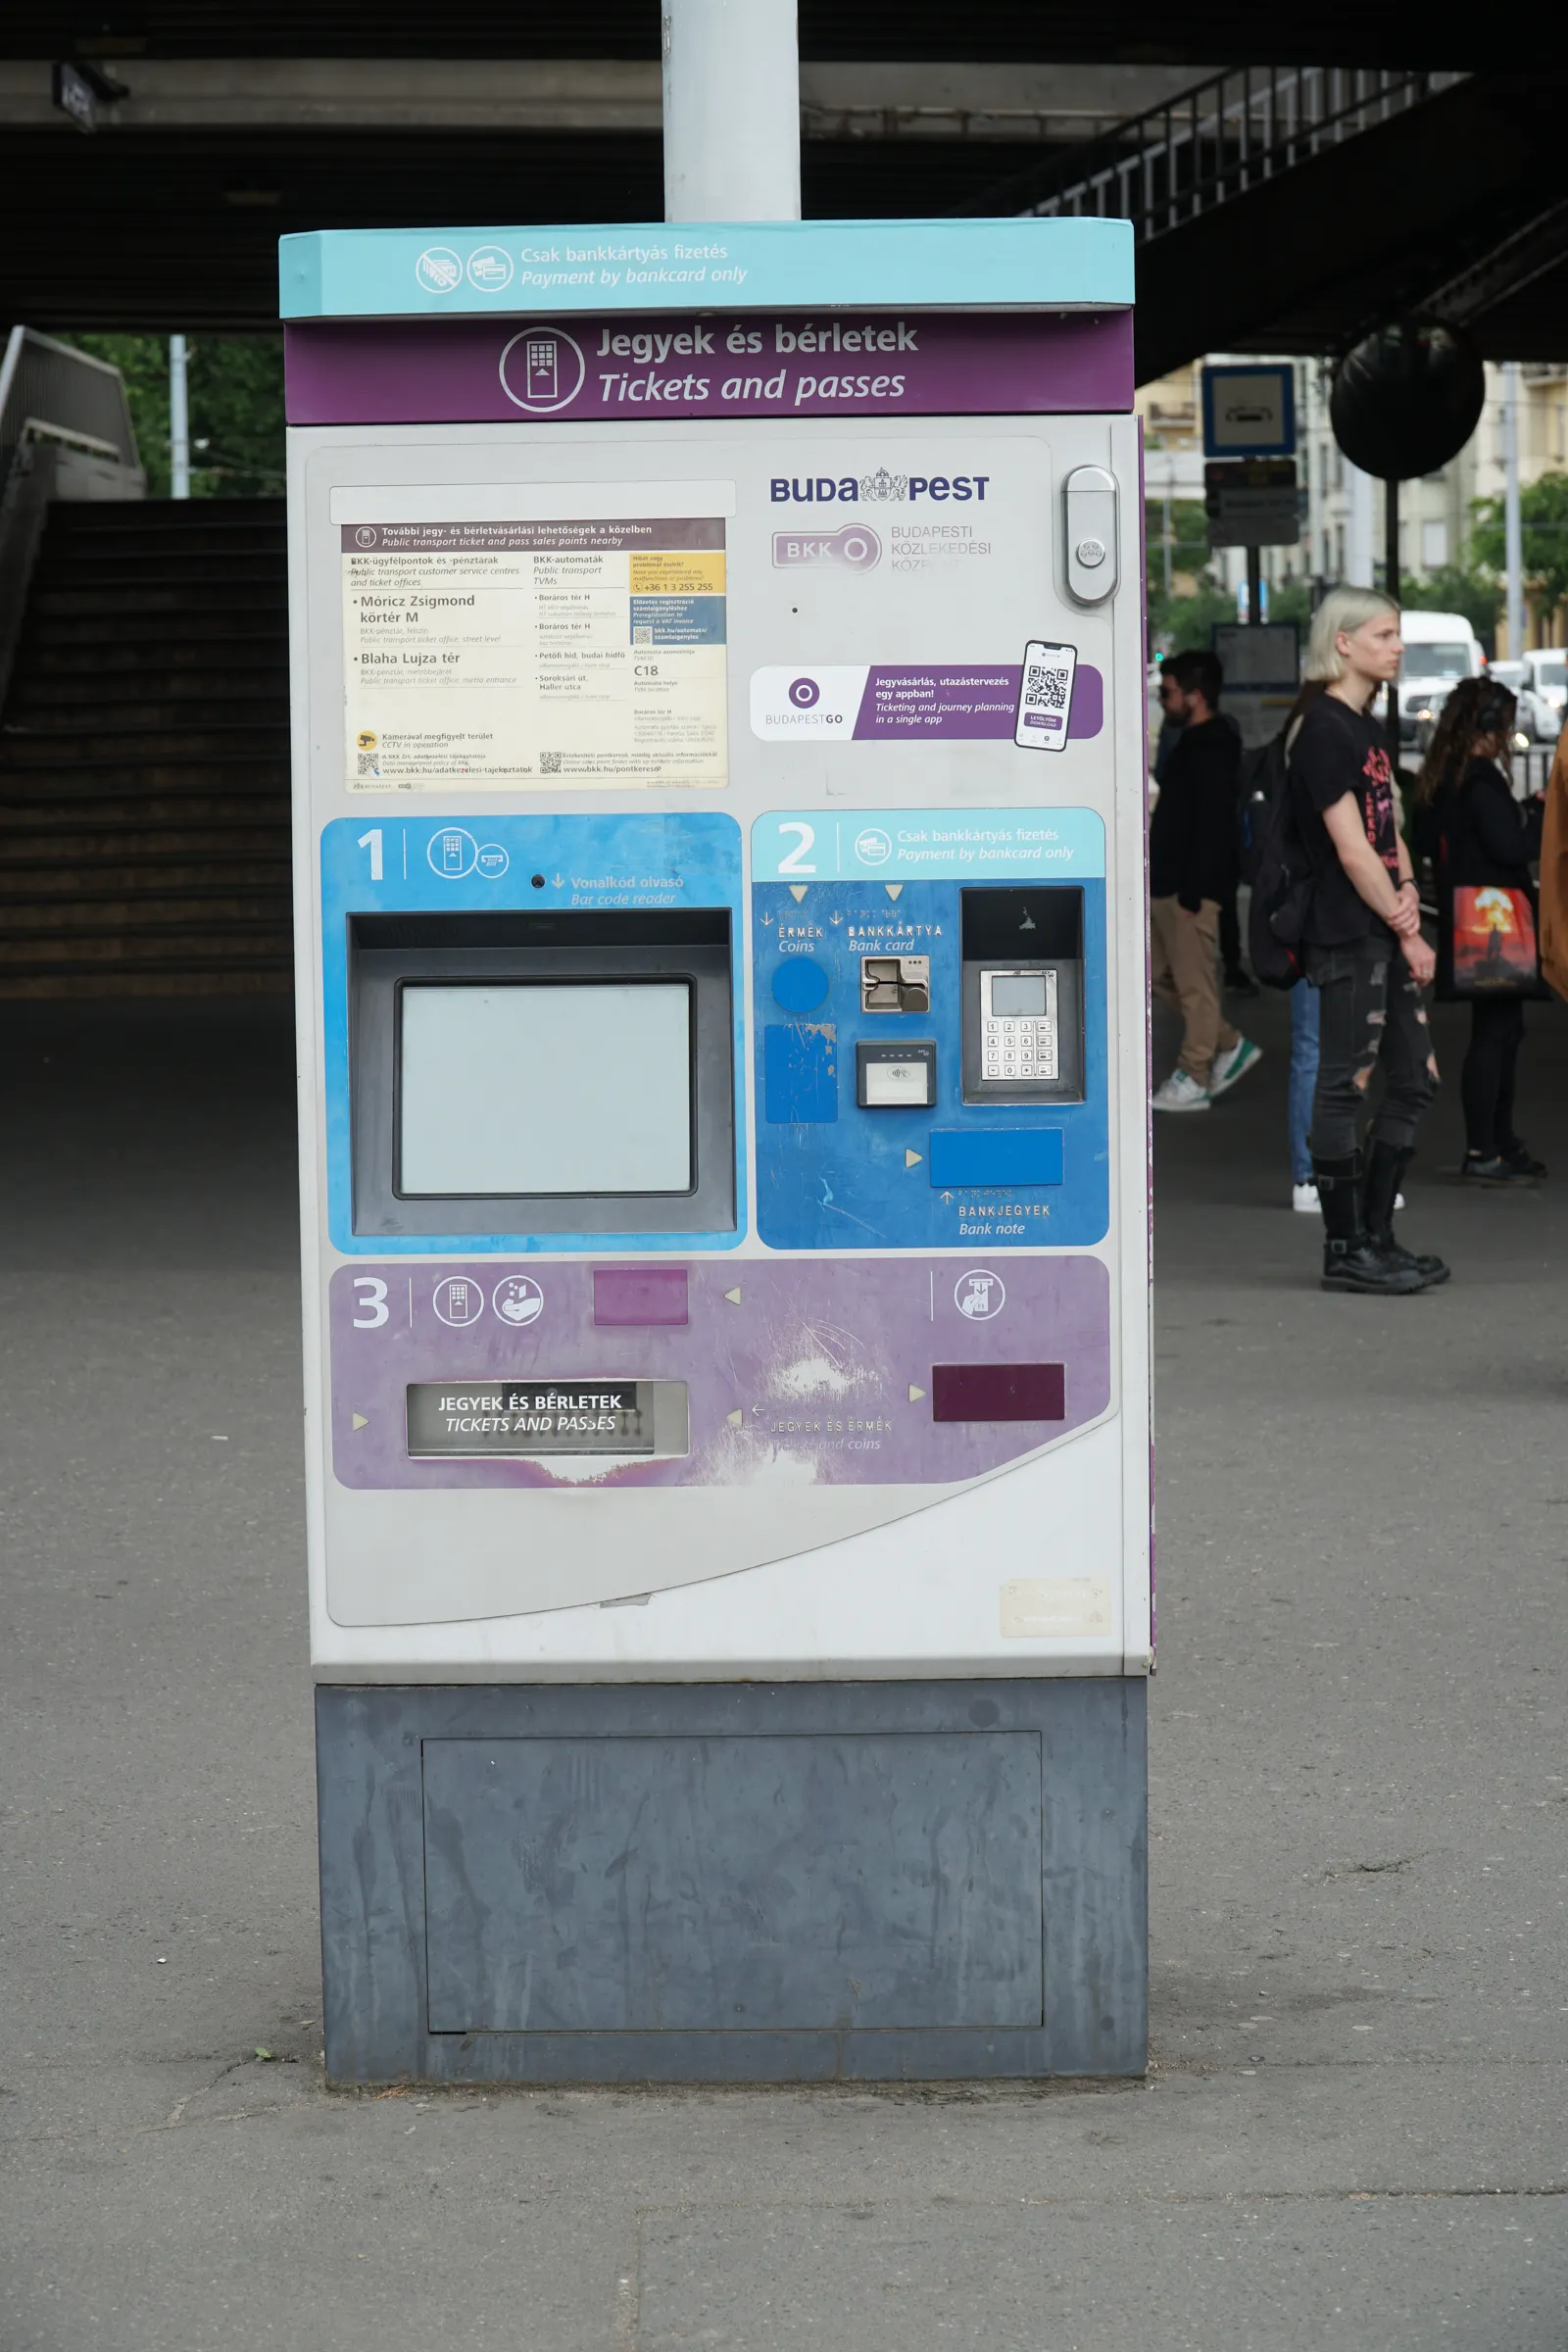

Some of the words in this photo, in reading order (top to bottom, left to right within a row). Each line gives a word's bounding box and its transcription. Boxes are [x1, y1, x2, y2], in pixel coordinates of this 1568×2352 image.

[521, 247, 560, 262] Csak
[566, 245, 667, 264] bankkártyás
[674, 244, 727, 259] fizetés
[521, 270, 595, 288] Payment
[600, 269, 620, 287] by
[626, 267, 705, 283] bankcard
[711, 267, 747, 284] only
[597, 325, 714, 364] Jegyek
[726, 324, 762, 354] és
[776, 321, 918, 353] bérletek
[599, 371, 710, 402] Tickets
[720, 369, 786, 400] and
[795, 374, 906, 406] passes
[465, 526, 534, 535] bérletvásárlási
[538, 526, 596, 535] lehetőségek
[610, 525, 652, 534] közelben
[414, 538, 456, 547] transport
[559, 536, 587, 546] points
[591, 536, 622, 546] nearby
[787, 542, 833, 558] BKK
[891, 526, 972, 538] BUDAPESTI
[891, 540, 991, 555] KÖZLEKEDÉSI
[351, 557, 433, 566] BKK-ügyfélpontok
[351, 567, 375, 576] Public
[378, 567, 416, 576] transport
[562, 566, 602, 575] transport
[394, 578, 420, 588] offices
[361, 596, 405, 607] Móricz
[411, 595, 475, 609] Zsigmond
[361, 612, 401, 622] körtér
[406, 612, 418, 622] M
[362, 653, 397, 663] Blaha
[403, 653, 436, 665] Lujza
[442, 653, 460, 662] tér
[634, 665, 659, 676] C18
[876, 677, 937, 687] Jegyvásárlás,
[940, 677, 1008, 687] utazástervezés
[876, 690, 893, 700] egy
[896, 689, 934, 700] appban!
[876, 703, 915, 713] Ticketing
[918, 703, 936, 712] and
[938, 702, 970, 713] journey
[975, 702, 1014, 713] planning
[766, 714, 843, 724] BUDAPESTGO
[896, 714, 922, 725] single
[925, 716, 942, 725] app
[413, 741, 448, 750] operation
[898, 830, 928, 843] Csak
[933, 828, 1012, 845] bankkártyás
[1016, 827, 1058, 841] fizetés
[778, 822, 816, 873] 2
[898, 848, 956, 862] Payment
[959, 848, 975, 860] by
[979, 846, 1041, 859] bankcard
[1046, 846, 1074, 860] only
[357, 829, 383, 881] 1
[571, 876, 635, 890] Vonalkód
[640, 873, 683, 888] olvasó
[571, 893, 593, 906] Bar
[598, 893, 629, 905] code
[633, 892, 676, 904] reader
[778, 922, 823, 938] ÉRMÉK
[849, 922, 942, 937] BANKKÁRTYA
[779, 940, 814, 953] Coins
[849, 939, 882, 953] Bank
[886, 939, 914, 952] card
[958, 1205, 1050, 1217] BANKJEGYEK
[959, 1223, 991, 1235] Bank
[996, 1223, 1025, 1235] note
[352, 1277, 389, 1329] 3
[439, 1396, 503, 1411] JEGYEK
[509, 1393, 529, 1410] ÉS
[535, 1393, 621, 1410] BÉRLETEK
[446, 1416, 510, 1433] TICKETS
[514, 1416, 552, 1432] AND
[557, 1415, 616, 1431] PASSES
[770, 1419, 821, 1433] JEGYEK
[827, 1417, 843, 1433] ÉS
[848, 1416, 892, 1432] ÉRMÉK
[848, 1438, 881, 1450] coins
